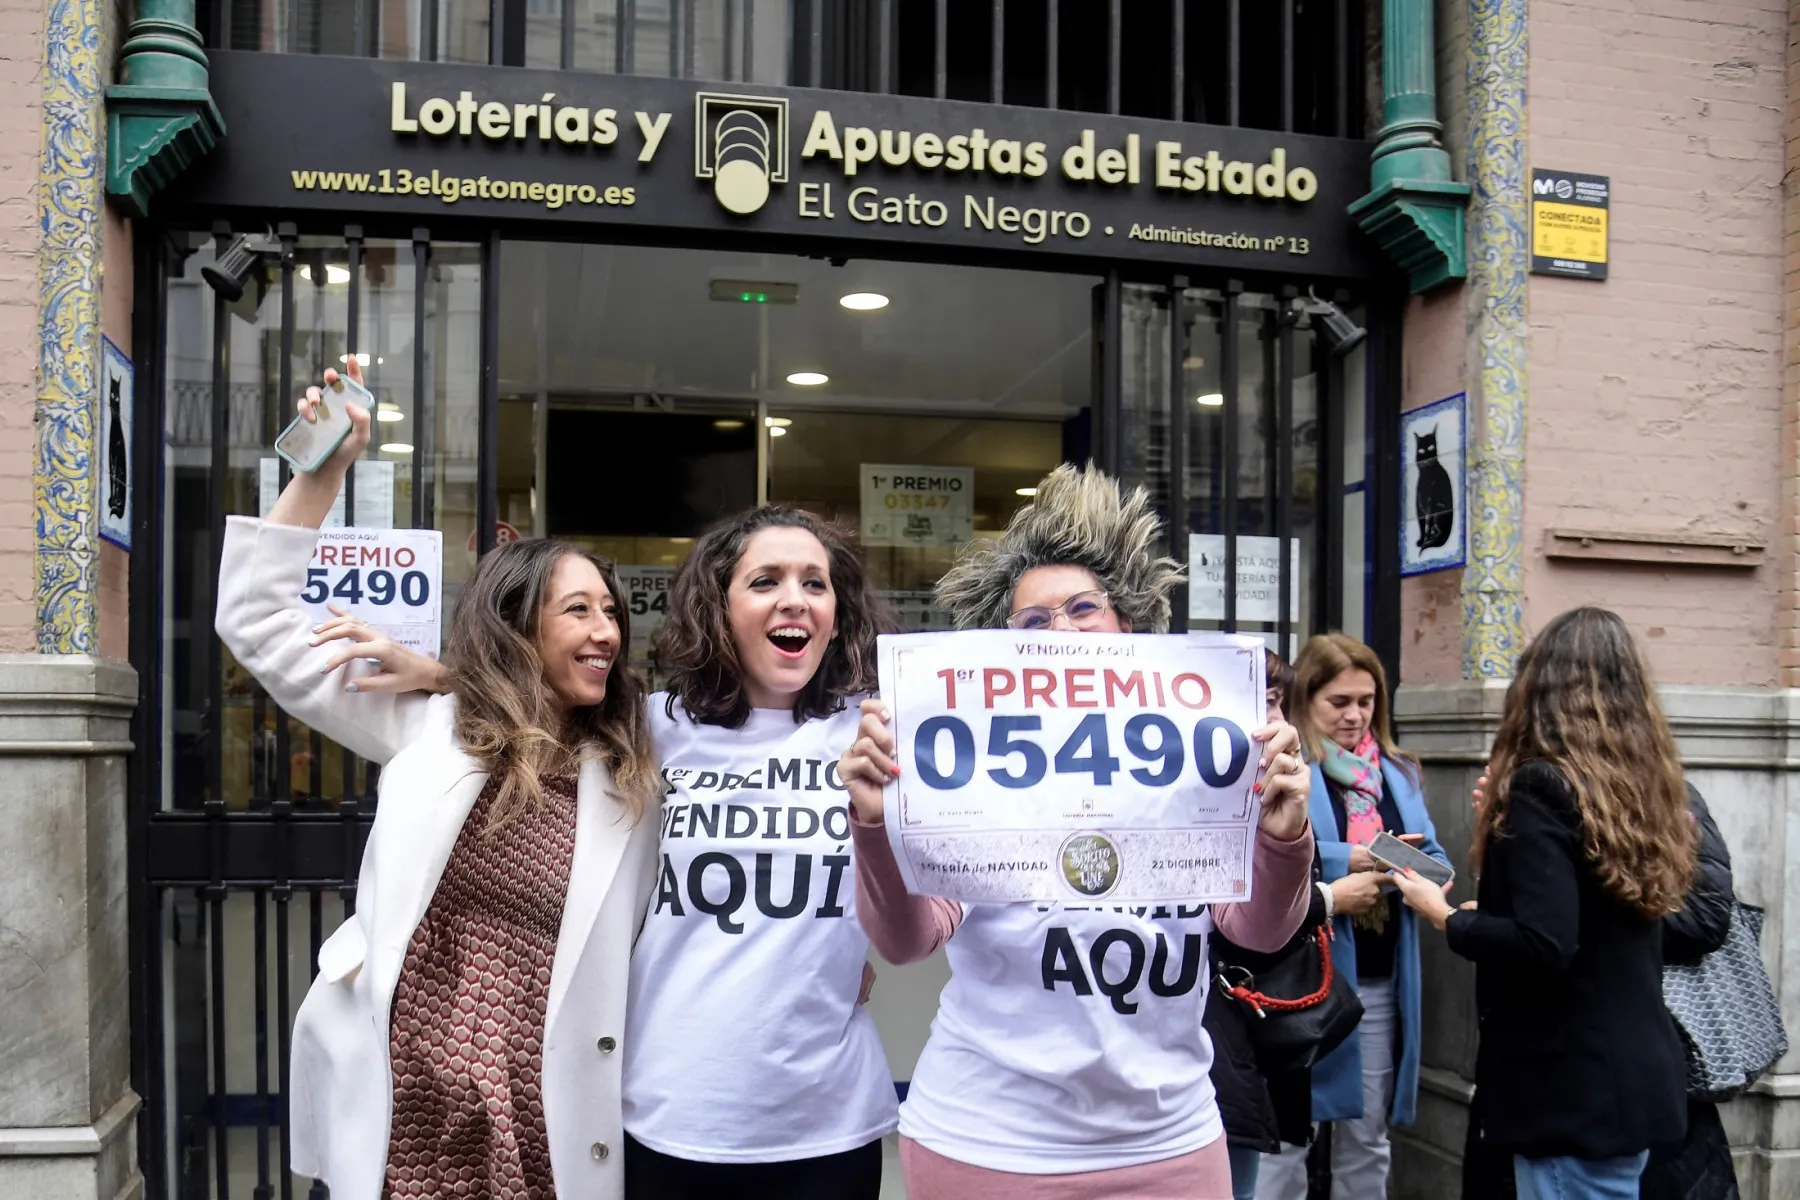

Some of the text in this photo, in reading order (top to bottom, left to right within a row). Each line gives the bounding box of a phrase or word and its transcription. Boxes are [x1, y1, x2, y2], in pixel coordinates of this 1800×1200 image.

[390, 81, 1319, 203] Loterías y Apuestas del Estado
[291, 168, 636, 209] www.13elgatonegro.es
[798, 183, 834, 219] El
[847, 187, 949, 227] Gato
[964, 195, 1091, 244] Negro
[1128, 222, 1260, 251] Administración
[1289, 237, 1310, 255] 13
[893, 476, 962, 492] PREMIO
[358, 533, 379, 542] AQUÍ
[1236, 555, 1255, 567] STÁ
[1015, 643, 1136, 658] VENDIDO AQUÍ
[983, 667, 1212, 710] PREMIO
[914, 713, 1250, 791] 05490
[987, 861, 1048, 872] NAVIDAD
[1152, 858, 1221, 870] 22 DICIEMBRE
[654, 845, 851, 935] AQUÍ
[1041, 927, 1205, 1015] AQU
